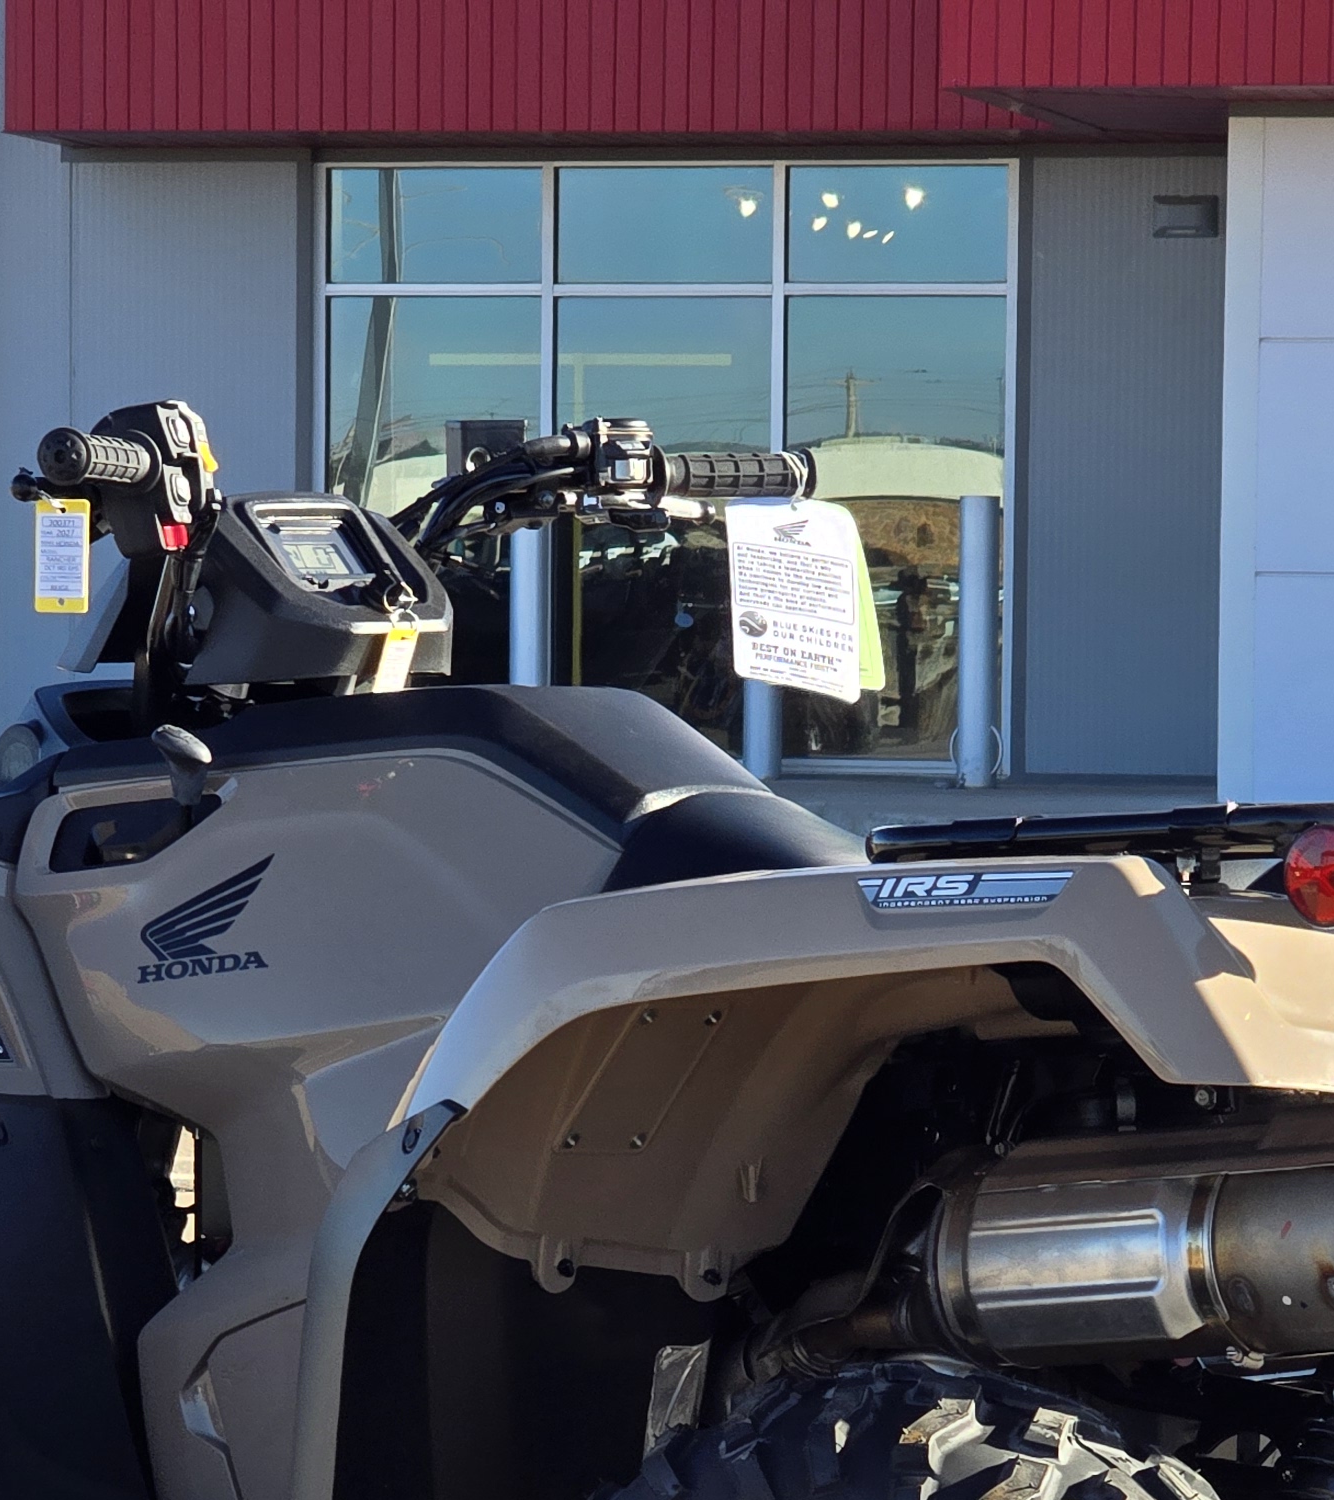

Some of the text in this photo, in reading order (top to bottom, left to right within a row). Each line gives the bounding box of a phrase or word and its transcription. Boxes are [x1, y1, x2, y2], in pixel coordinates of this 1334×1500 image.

[773, 620, 854, 643] BLUE SKIES FOR
[773, 630, 854, 653] OUR CHILDREN
[751, 641, 779, 654] BEST
[783, 647, 797, 657] ON
[879, 875, 975, 898] IRS
[879, 899, 951, 908] INDEPENDENT
[983, 895, 1048, 905] SUSPENSION
[137, 951, 268, 983] HONDA
